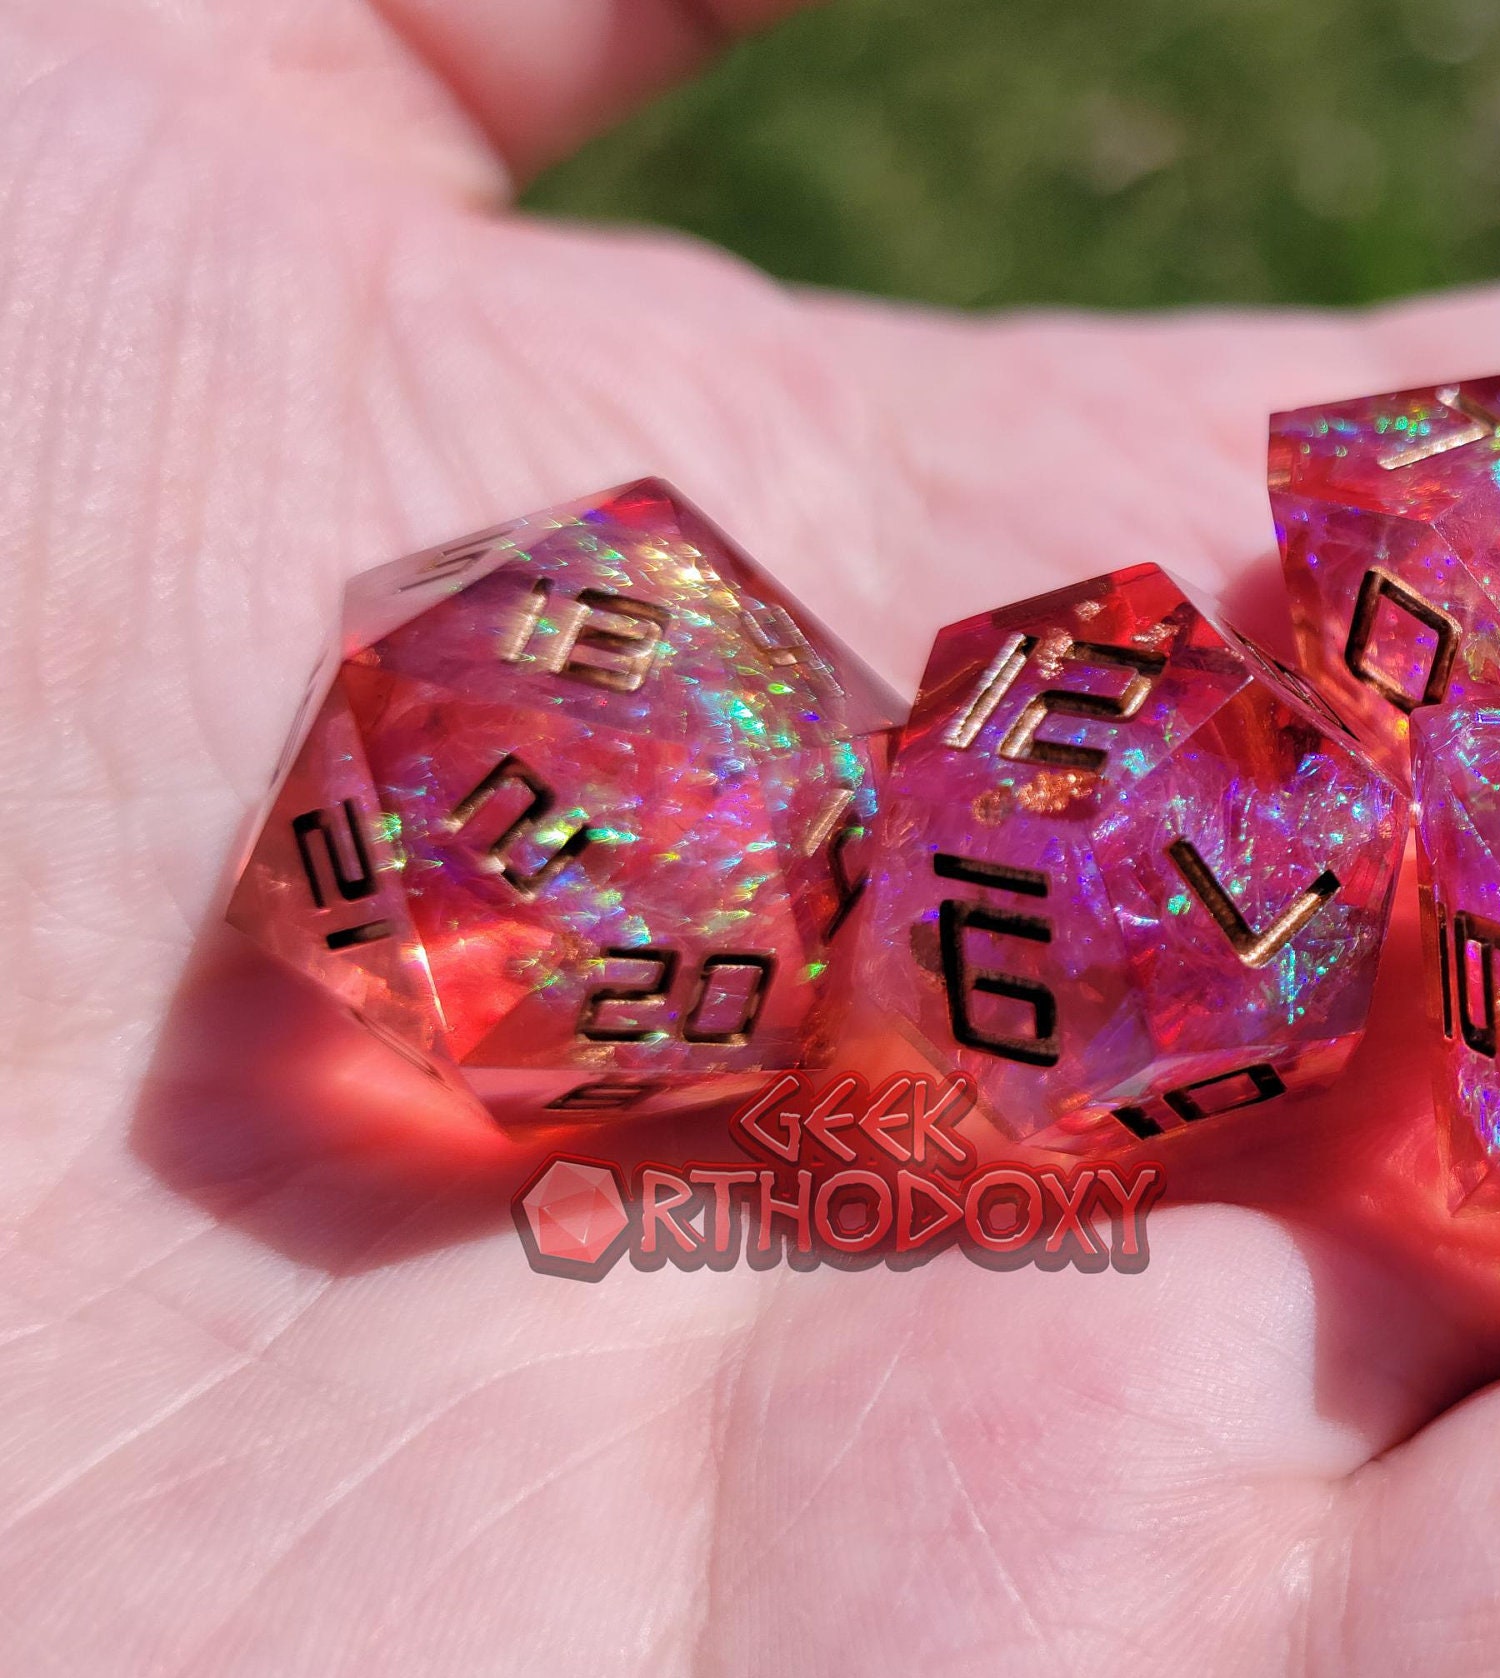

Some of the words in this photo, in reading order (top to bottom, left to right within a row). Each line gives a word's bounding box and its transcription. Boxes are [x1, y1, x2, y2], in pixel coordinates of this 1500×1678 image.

[940, 630, 1168, 771] 12
[1345, 566, 1463, 716] 0
[574, 947, 779, 1047] 20
